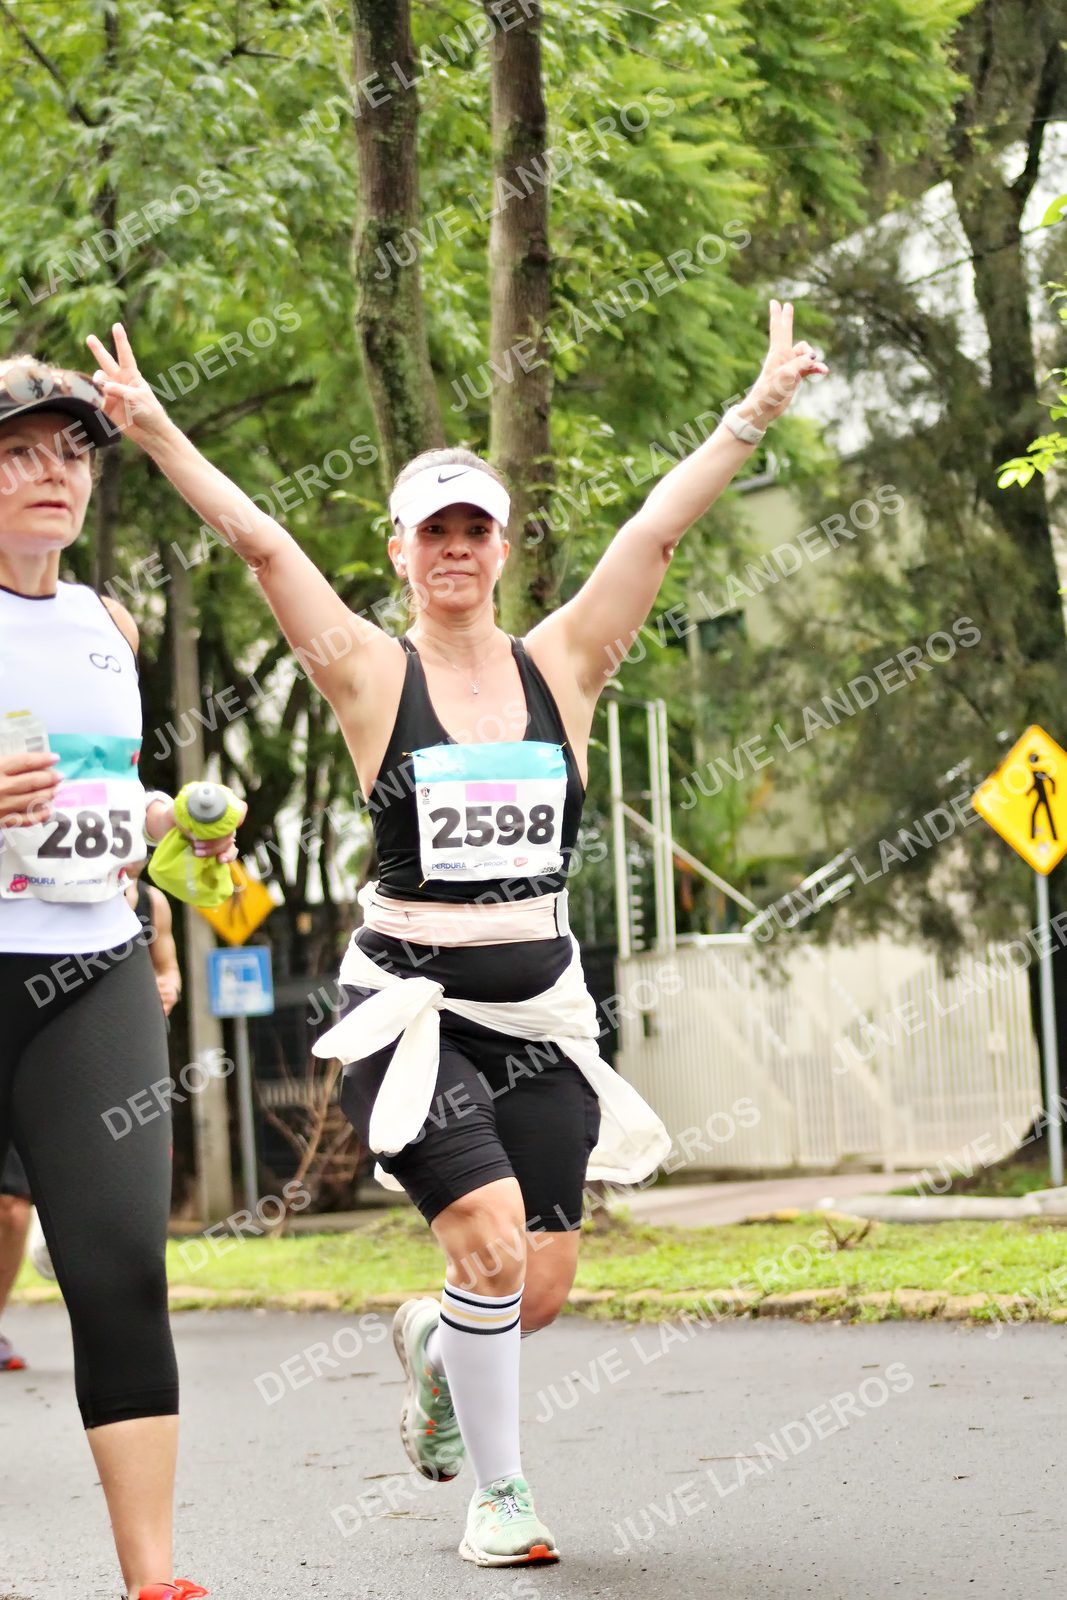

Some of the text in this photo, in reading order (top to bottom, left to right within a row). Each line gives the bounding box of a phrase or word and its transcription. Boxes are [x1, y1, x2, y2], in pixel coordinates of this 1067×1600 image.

[37, 809, 132, 859] 285
[428, 804, 555, 849] 2598
[432, 862, 467, 870] PERDURA
